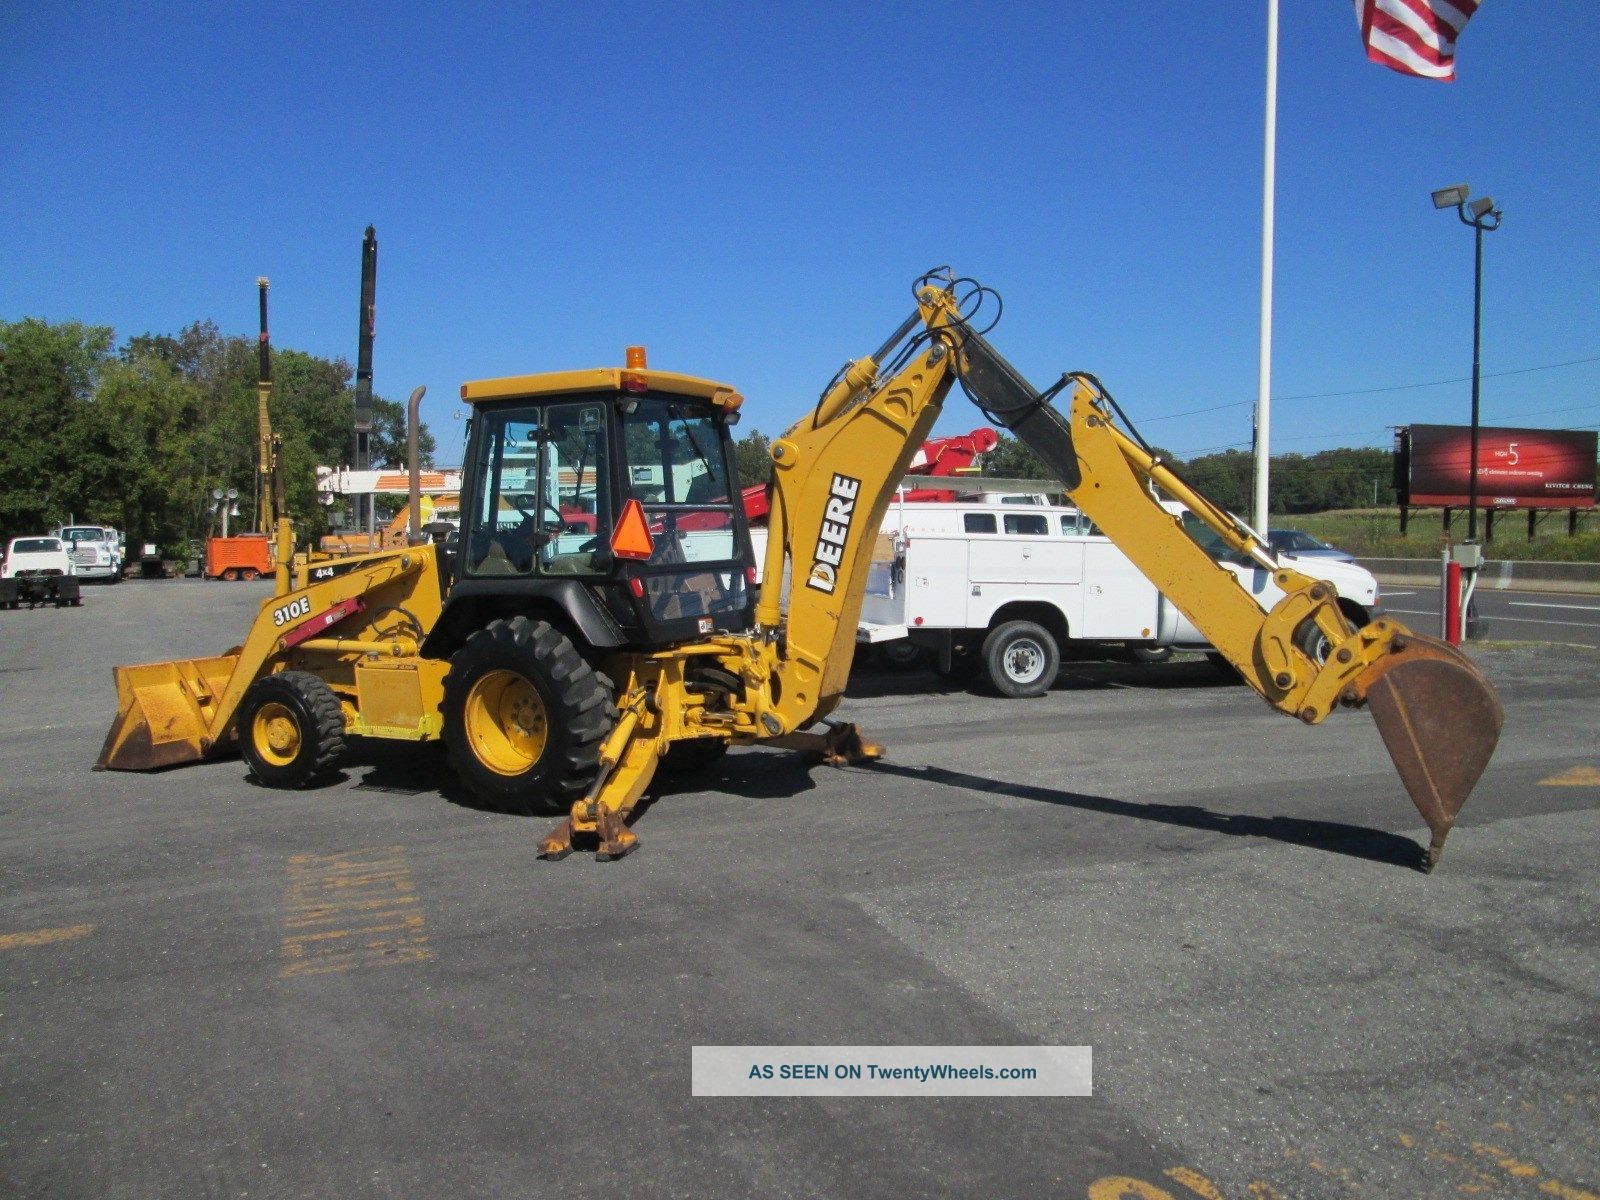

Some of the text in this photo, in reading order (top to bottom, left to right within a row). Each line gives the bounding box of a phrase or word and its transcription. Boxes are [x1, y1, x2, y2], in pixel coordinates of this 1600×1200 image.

[1508, 442, 1519, 466] 5
[806, 472, 861, 595] DEERE
[316, 567, 335, 579] 4x4
[274, 595, 311, 627] 310E
